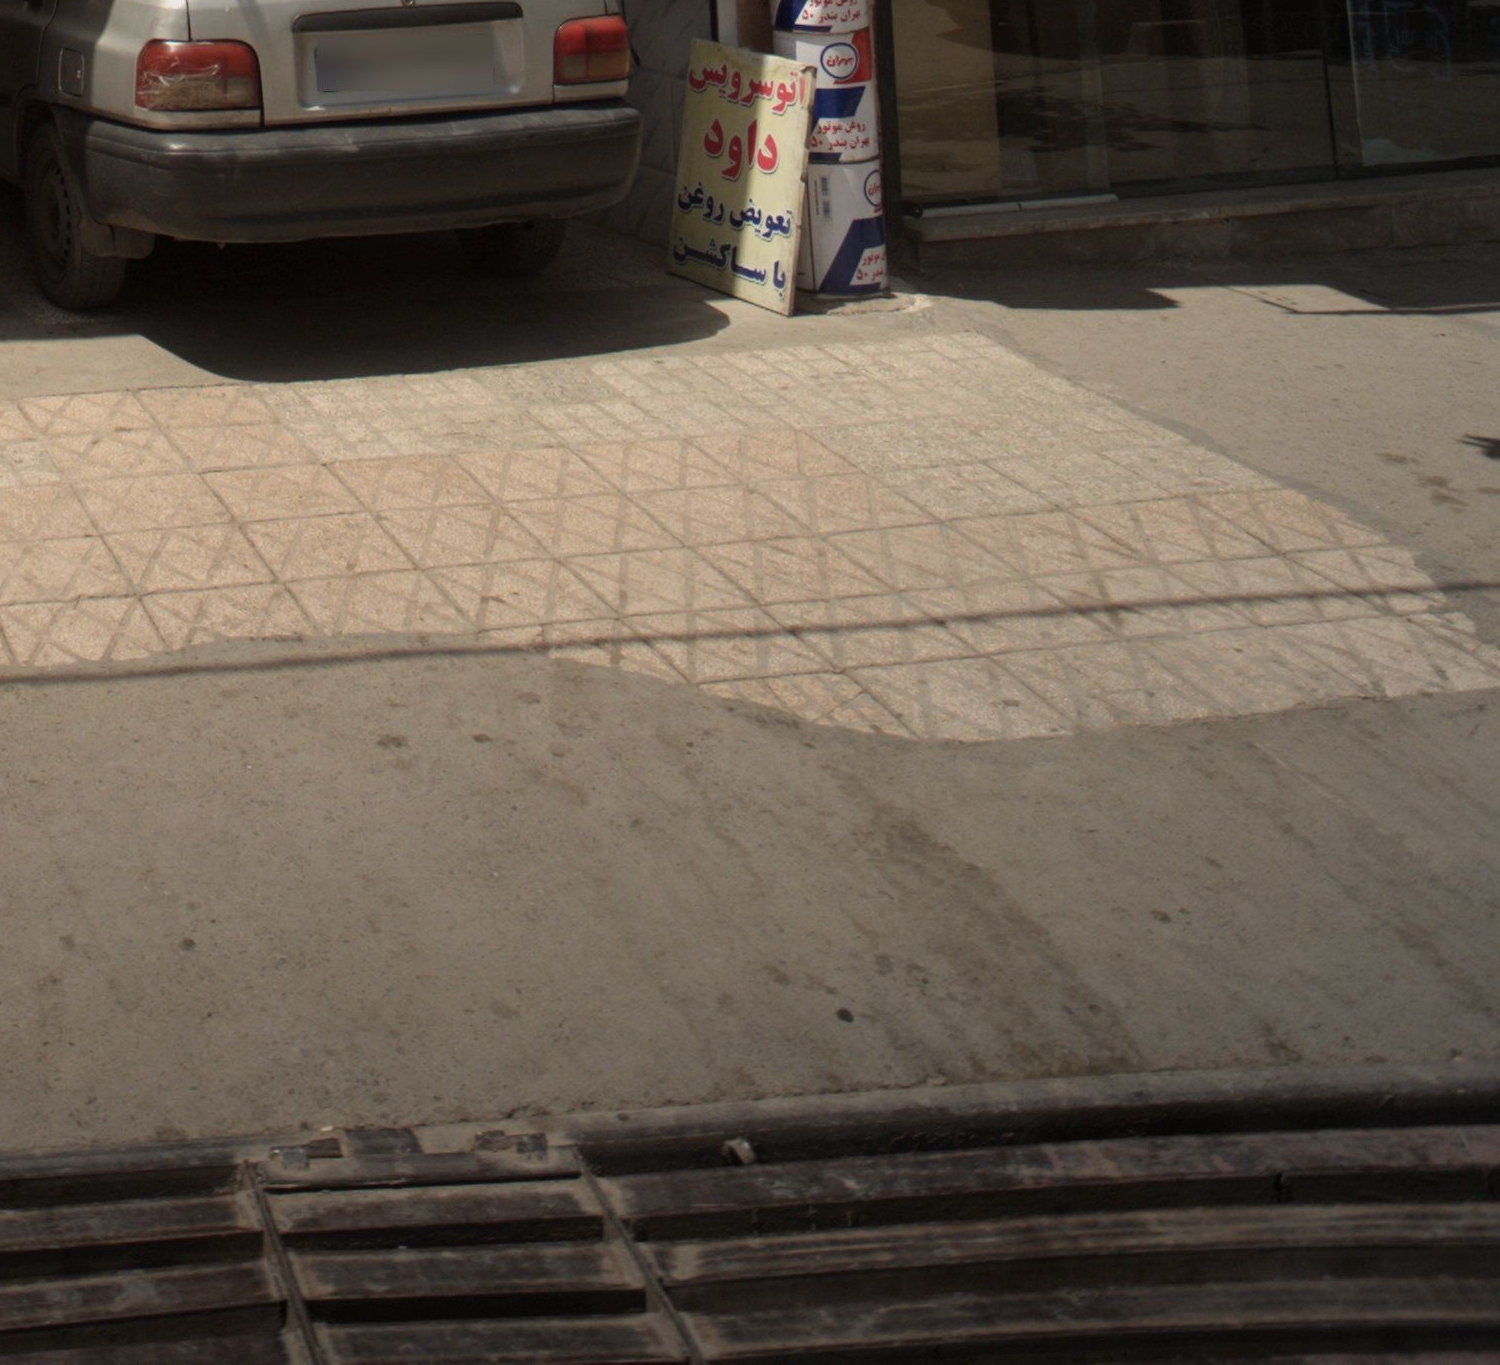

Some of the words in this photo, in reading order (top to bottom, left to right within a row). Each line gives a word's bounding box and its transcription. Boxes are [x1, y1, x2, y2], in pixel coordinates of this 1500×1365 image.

[703, 118, 779, 180] داود
[677, 180, 724, 223] روغن
[728, 197, 793, 239] تعویض
[772, 258, 787, 297] با
